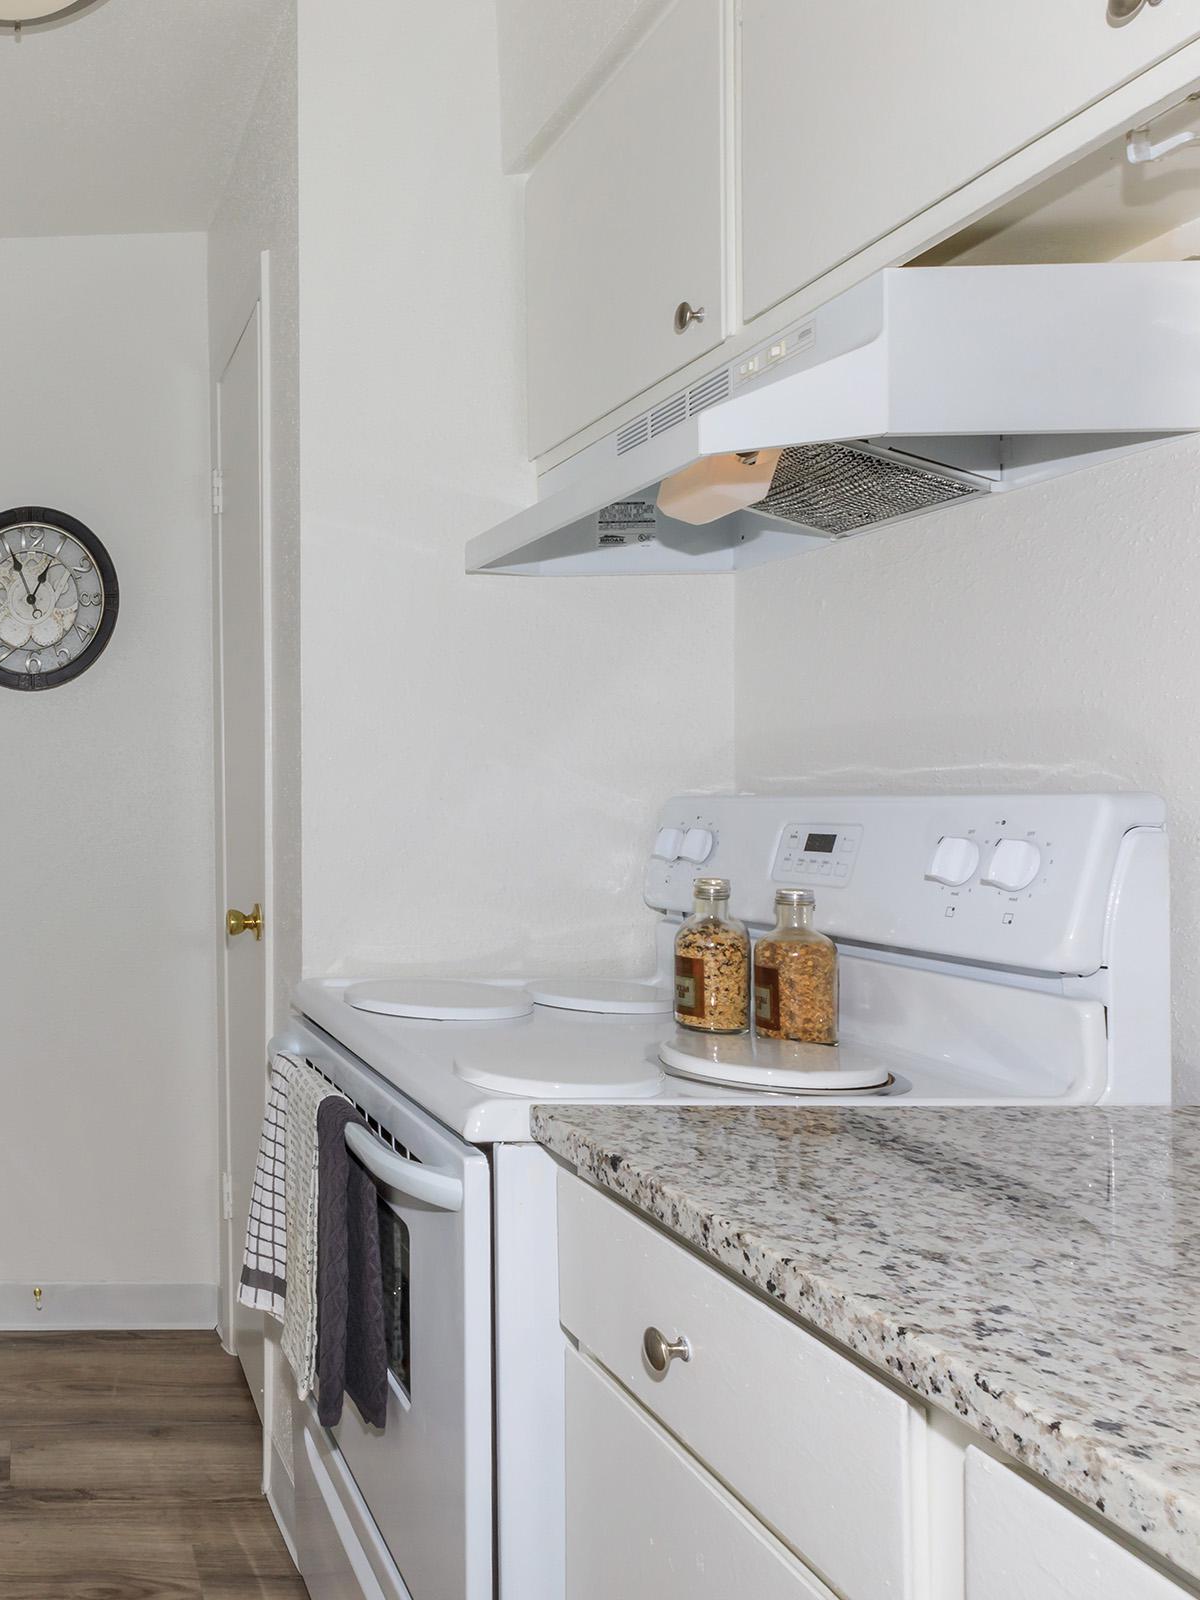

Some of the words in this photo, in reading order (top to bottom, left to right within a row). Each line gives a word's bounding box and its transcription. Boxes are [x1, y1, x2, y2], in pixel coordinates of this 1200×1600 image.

[17, 526, 46, 551] 12
[54, 533, 68, 557] 1
[70, 555, 93, 582] 2
[78, 591, 103, 609] 3
[75, 622, 97, 645] 4
[24, 650, 43, 675] 6
[52, 641, 73, 669] 5
